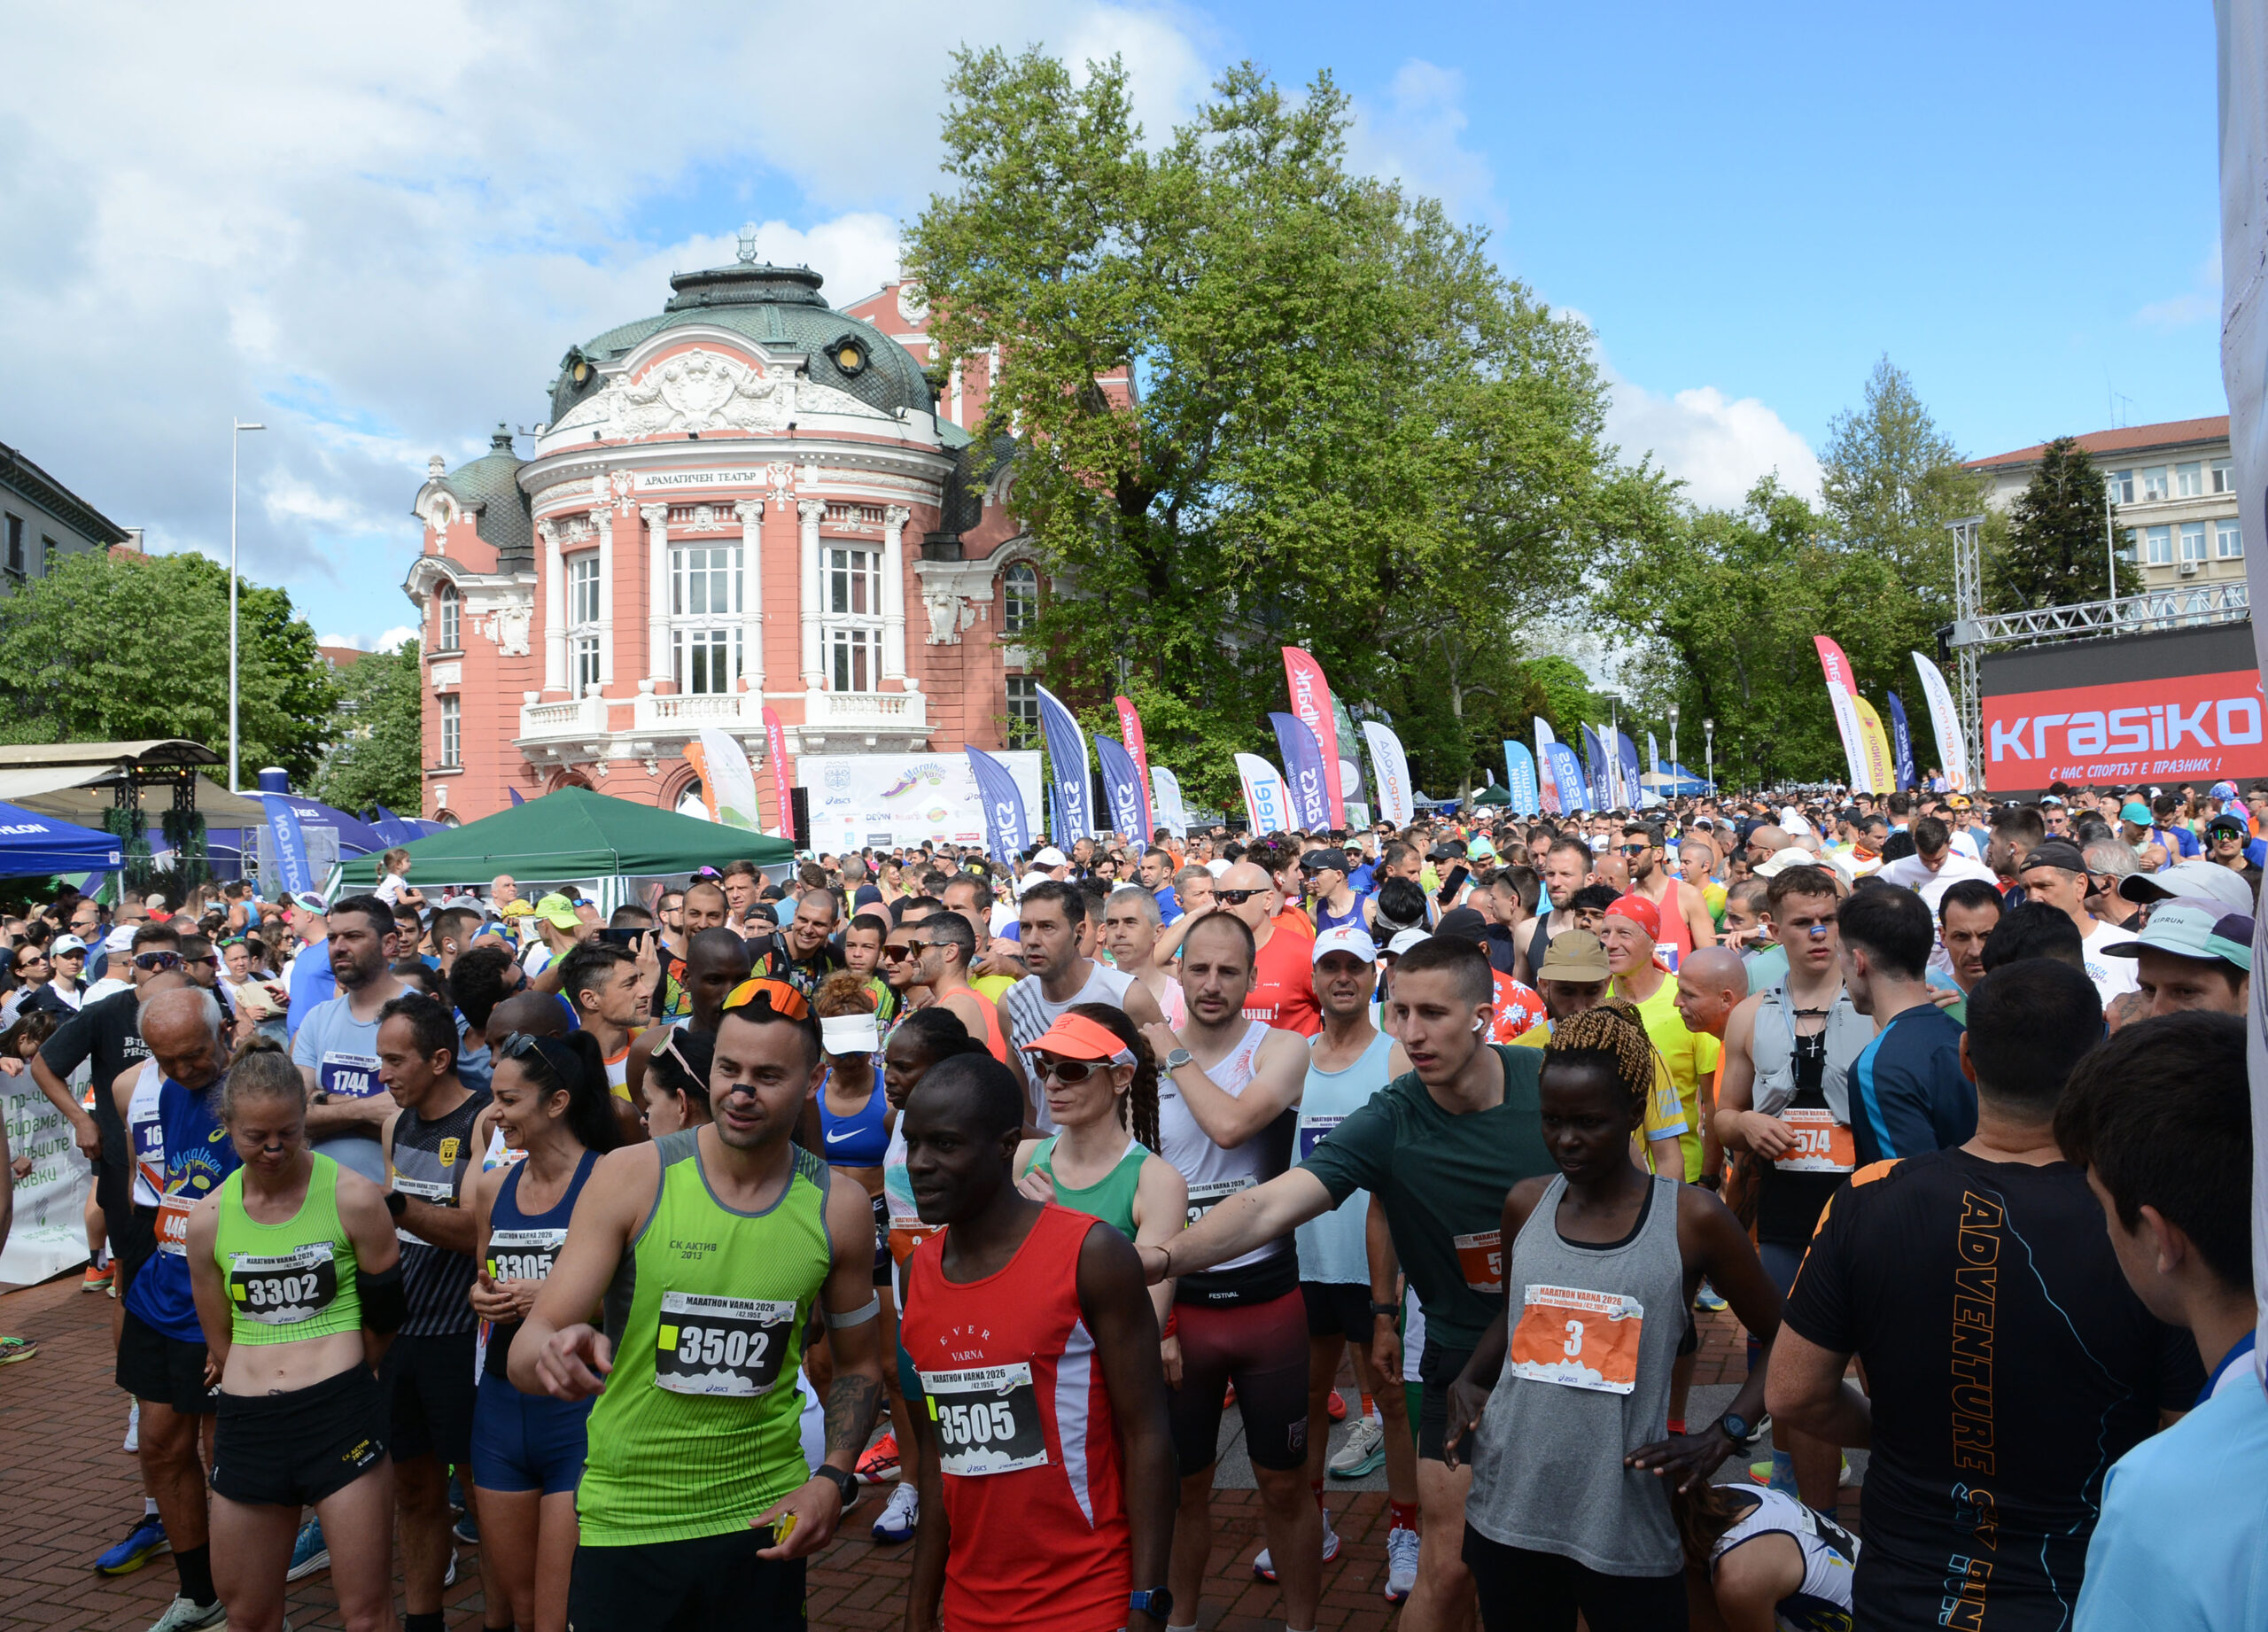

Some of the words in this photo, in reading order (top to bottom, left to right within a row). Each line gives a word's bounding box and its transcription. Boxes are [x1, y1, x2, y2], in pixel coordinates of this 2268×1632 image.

[644, 473, 714, 486] ДРАМАТИЧЕН
[717, 472, 757, 482] ТЕАТЪР
[2049, 767, 2059, 780] С
[2061, 765, 2084, 779] НАС
[2087, 762, 2138, 778] СПОРТЪТ
[2140, 762, 2148, 774] Е
[2153, 758, 2212, 773] ПРАЗНИК
[2215, 758, 2222, 772] !
[333, 1070, 369, 1094] 1744
[1793, 1129, 1831, 1153] 574
[298, 1251, 315, 1261] 2026
[670, 1240, 682, 1249] СК
[685, 1242, 717, 1252] АКТИВ
[681, 1250, 703, 1260] 2013
[496, 1254, 553, 1283] 3305
[248, 1273, 320, 1306] 3302
[1540, 1286, 1576, 1300] MARATHON
[1577, 1291, 1602, 1302] VARNA
[1602, 1294, 1622, 1306] 2026
[686, 1296, 727, 1308] MARATHON
[729, 1300, 754, 1310] VARNA
[755, 1302, 775, 1312] 2026
[940, 1325, 990, 1347] EVER
[1564, 1319, 1584, 1356] 3
[1951, 1190, 2003, 1476] ADVENTURE
[679, 1326, 769, 1367] 3502
[951, 1349, 984, 1362] VARNA
[932, 1372, 962, 1383] MARATHON
[963, 1371, 985, 1382] VARNA
[986, 1369, 1006, 1379] 2026
[938, 1401, 1016, 1444] 3505
